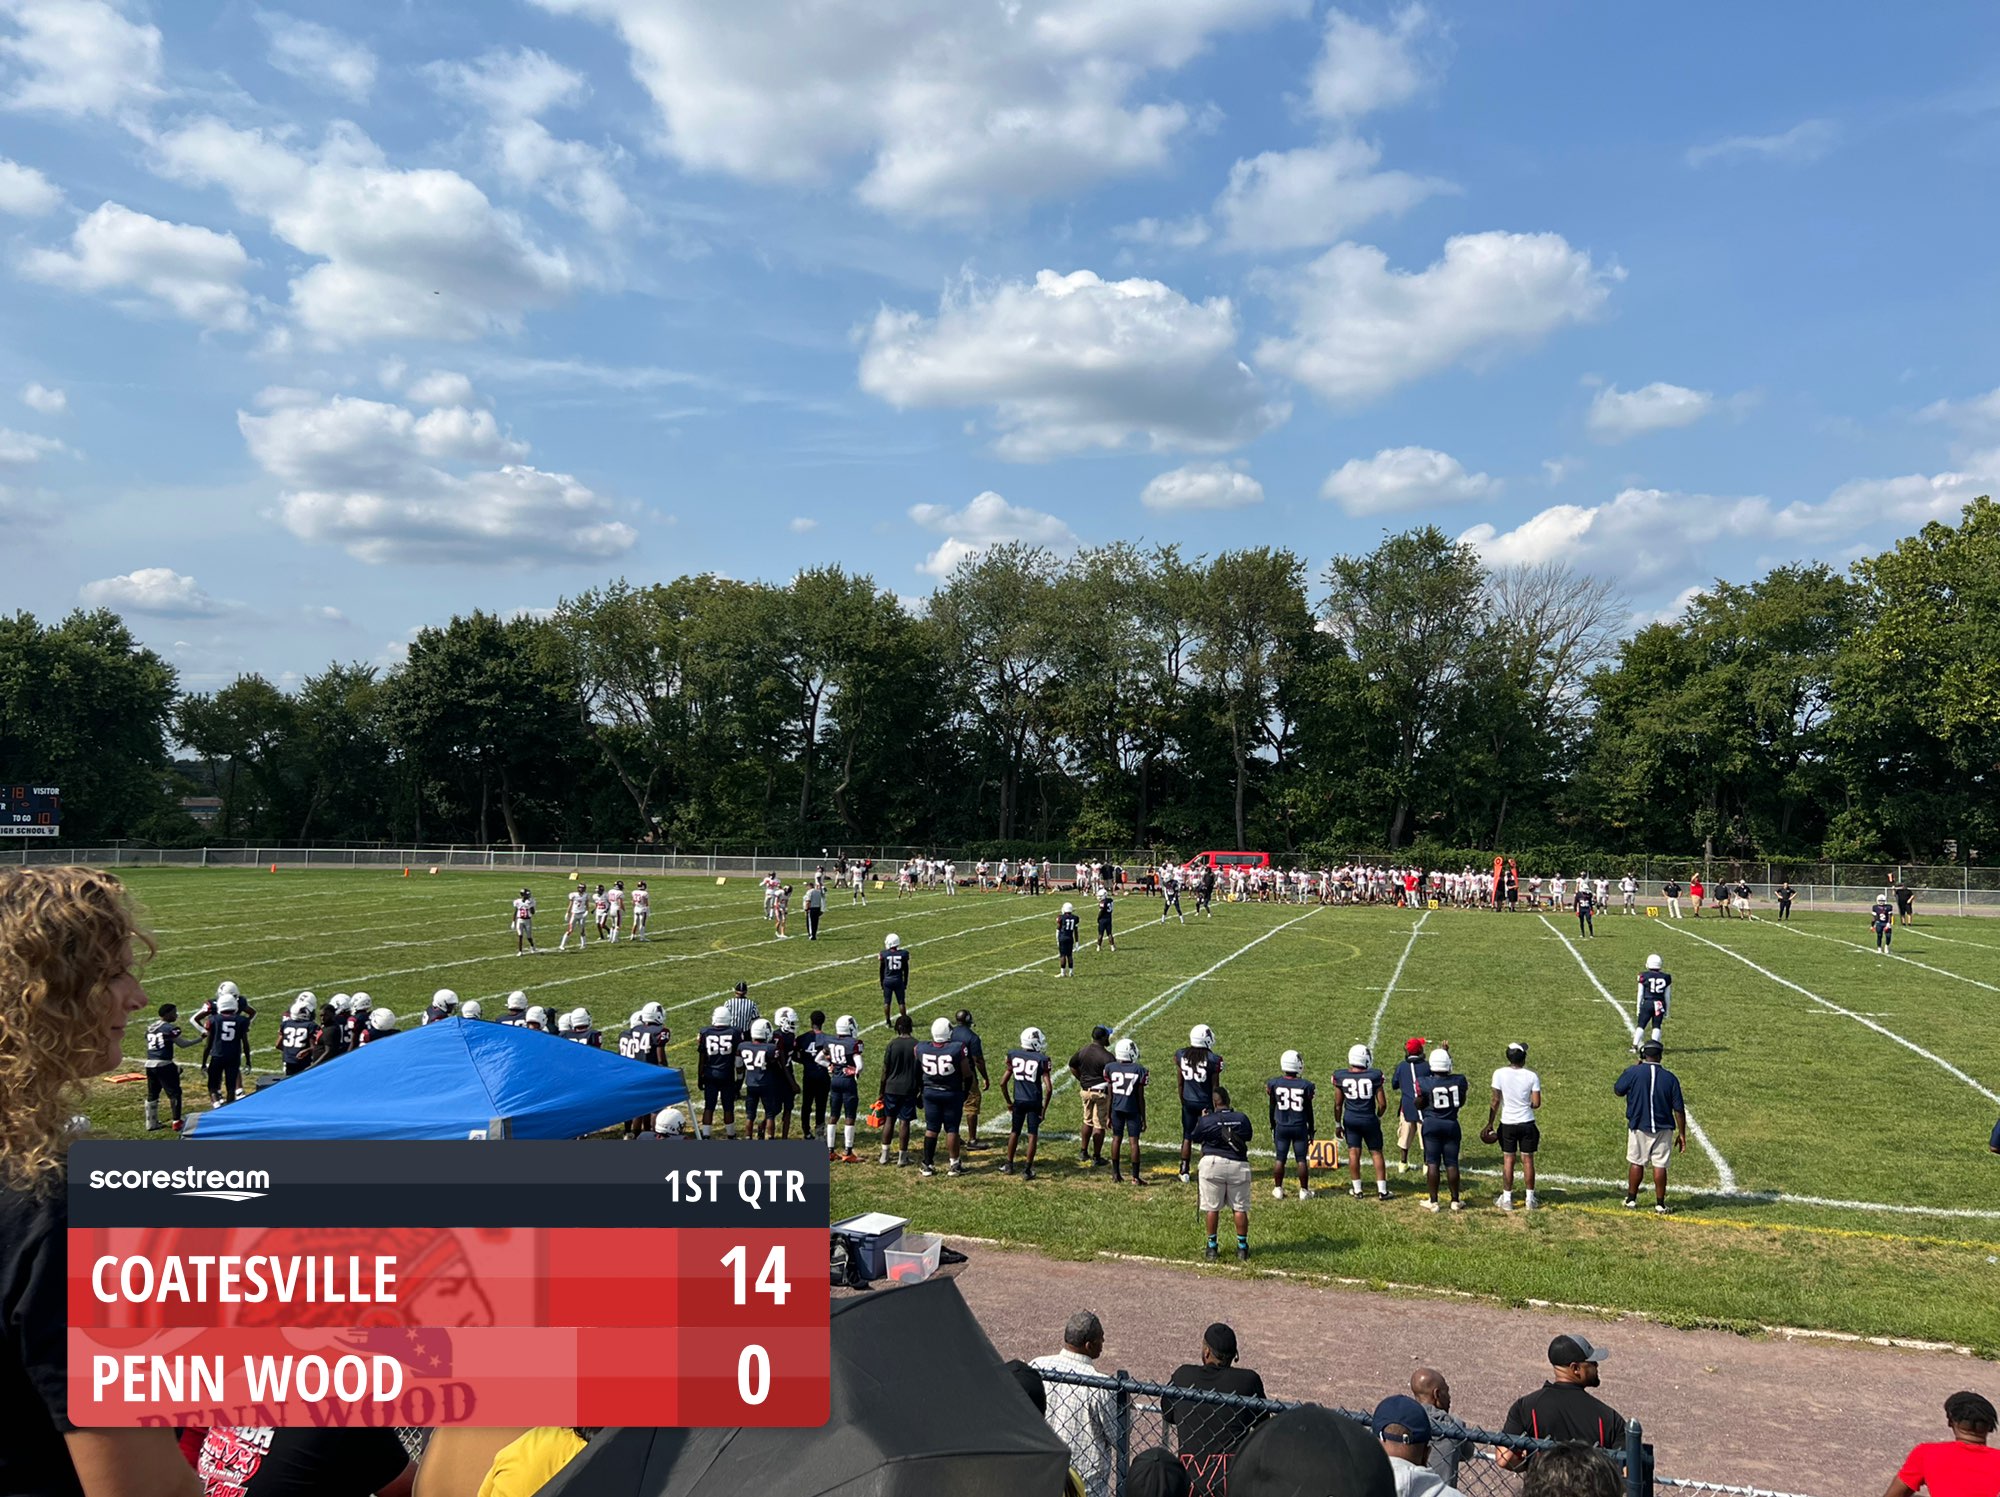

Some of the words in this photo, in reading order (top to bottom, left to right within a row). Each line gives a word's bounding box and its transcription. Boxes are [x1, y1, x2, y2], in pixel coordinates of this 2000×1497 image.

[33, 787, 60, 795] VISITOR
[12, 814, 21, 822] TO
[22, 814, 31, 822] GO
[38, 812, 50, 824] 10
[1879, 913, 1886, 921] 2
[886, 955, 902, 970] 15
[1648, 977, 1666, 993] 12
[221, 1021, 236, 1041] 5
[283, 1026, 308, 1048] 32
[632, 1031, 651, 1051] 54
[619, 1037, 635, 1059] 60
[705, 1034, 733, 1056] 65
[805, 1042, 817, 1056] 4
[827, 1043, 847, 1064] 10
[741, 1049, 767, 1071] 24
[921, 1053, 956, 1076] 56
[1011, 1056, 1039, 1083] 29
[1180, 1056, 1207, 1083] 55
[1110, 1071, 1139, 1096] 27
[1342, 1078, 1373, 1100] 30
[1275, 1086, 1305, 1112] 35
[1432, 1085, 1460, 1109] 61
[1310, 1142, 1335, 1166] 40
